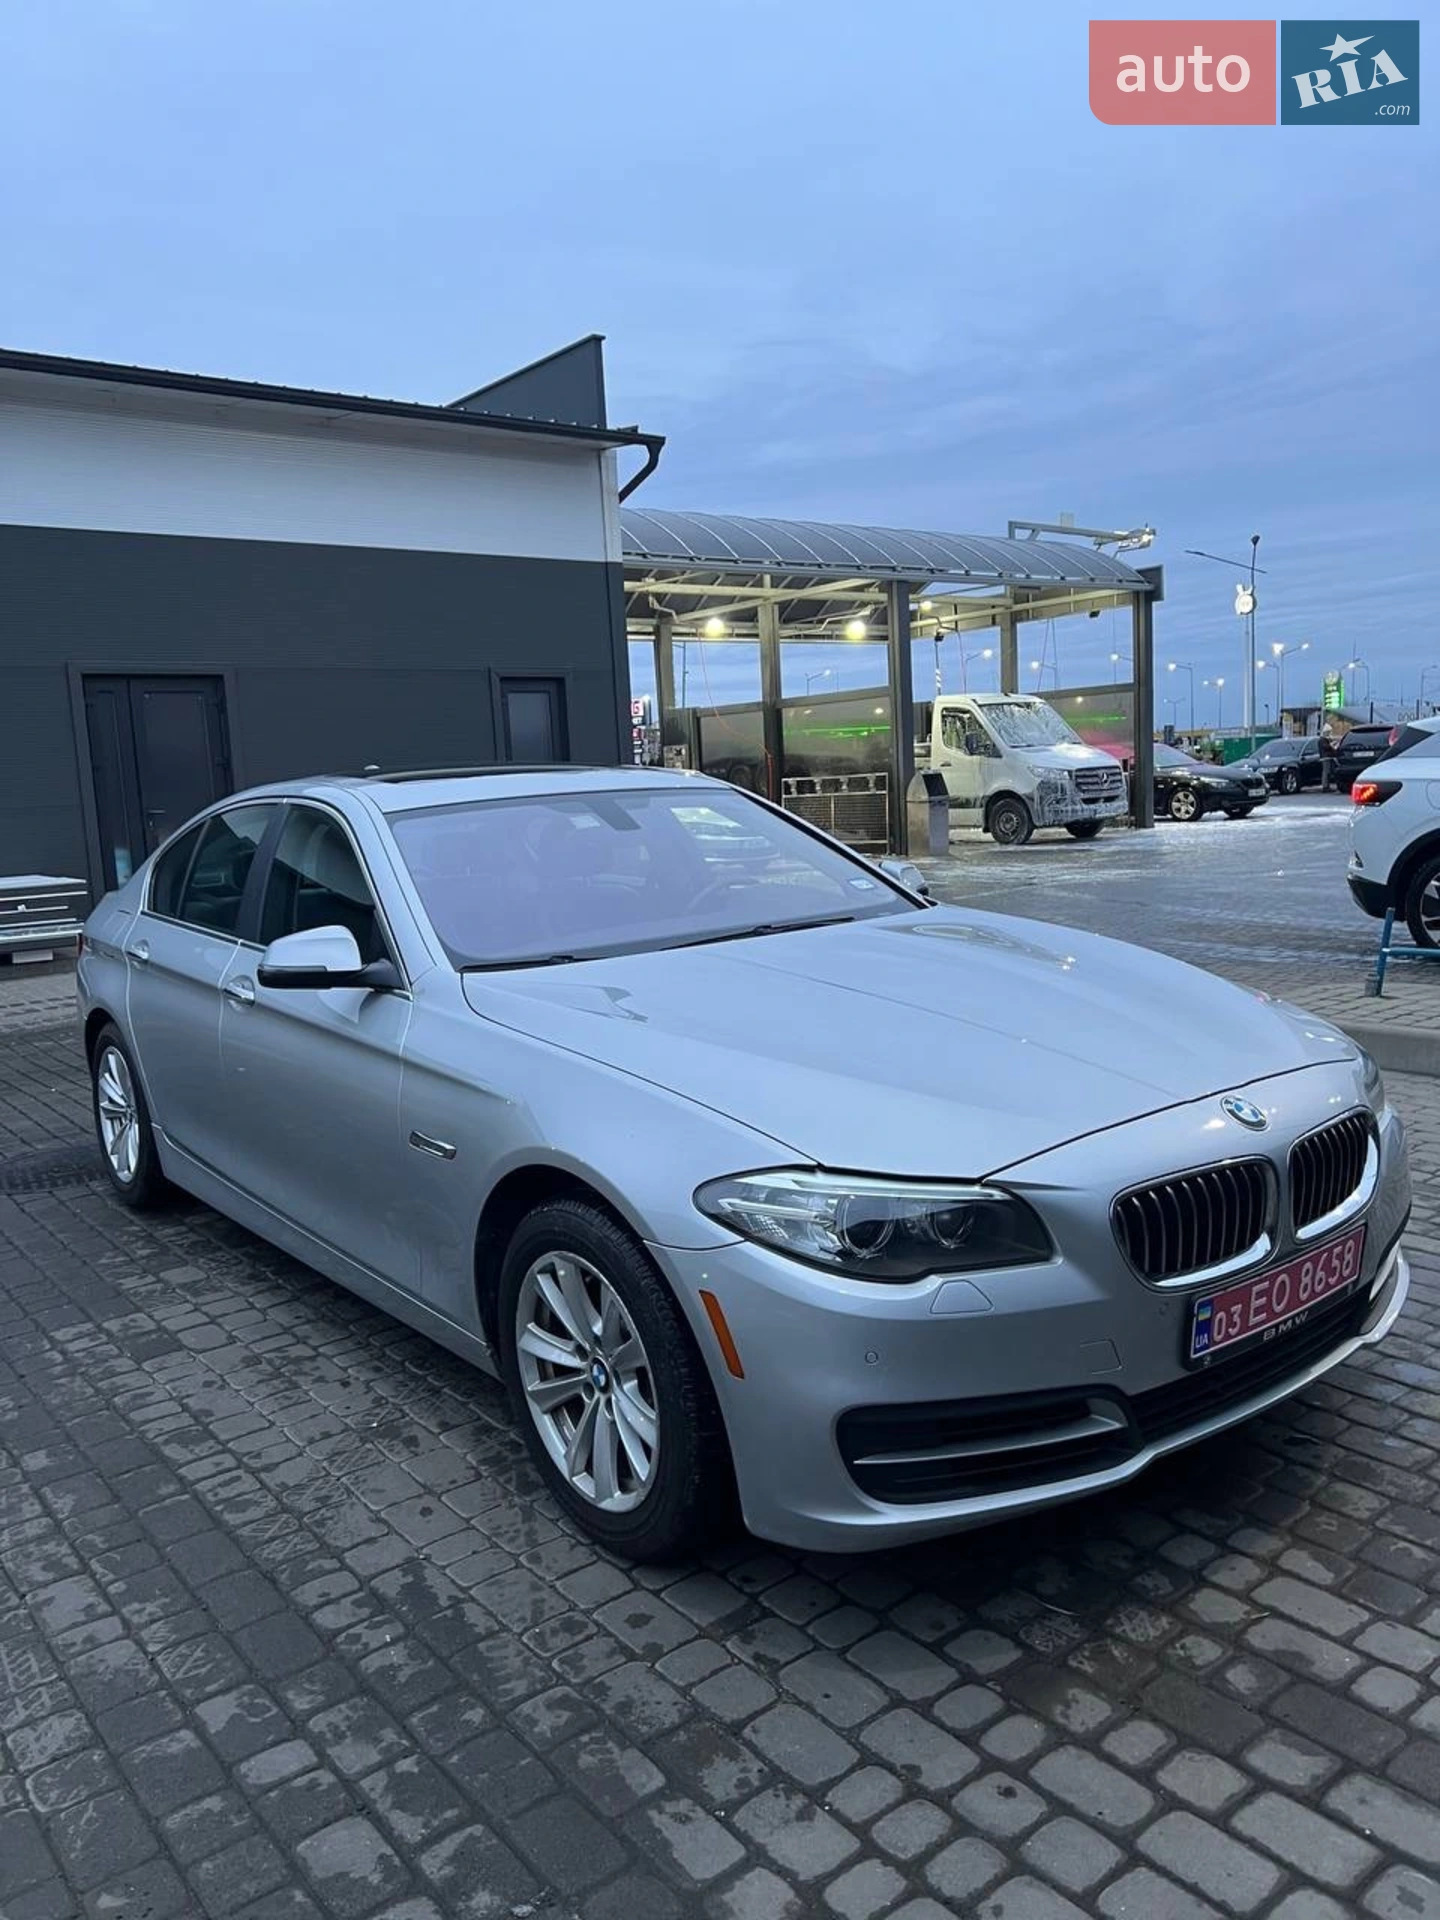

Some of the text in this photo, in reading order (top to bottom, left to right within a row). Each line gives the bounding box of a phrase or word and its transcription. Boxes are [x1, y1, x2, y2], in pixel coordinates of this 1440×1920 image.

[1213, 1239, 1356, 1342] 03 EO 8658
[1195, 1333, 1208, 1347] UA
